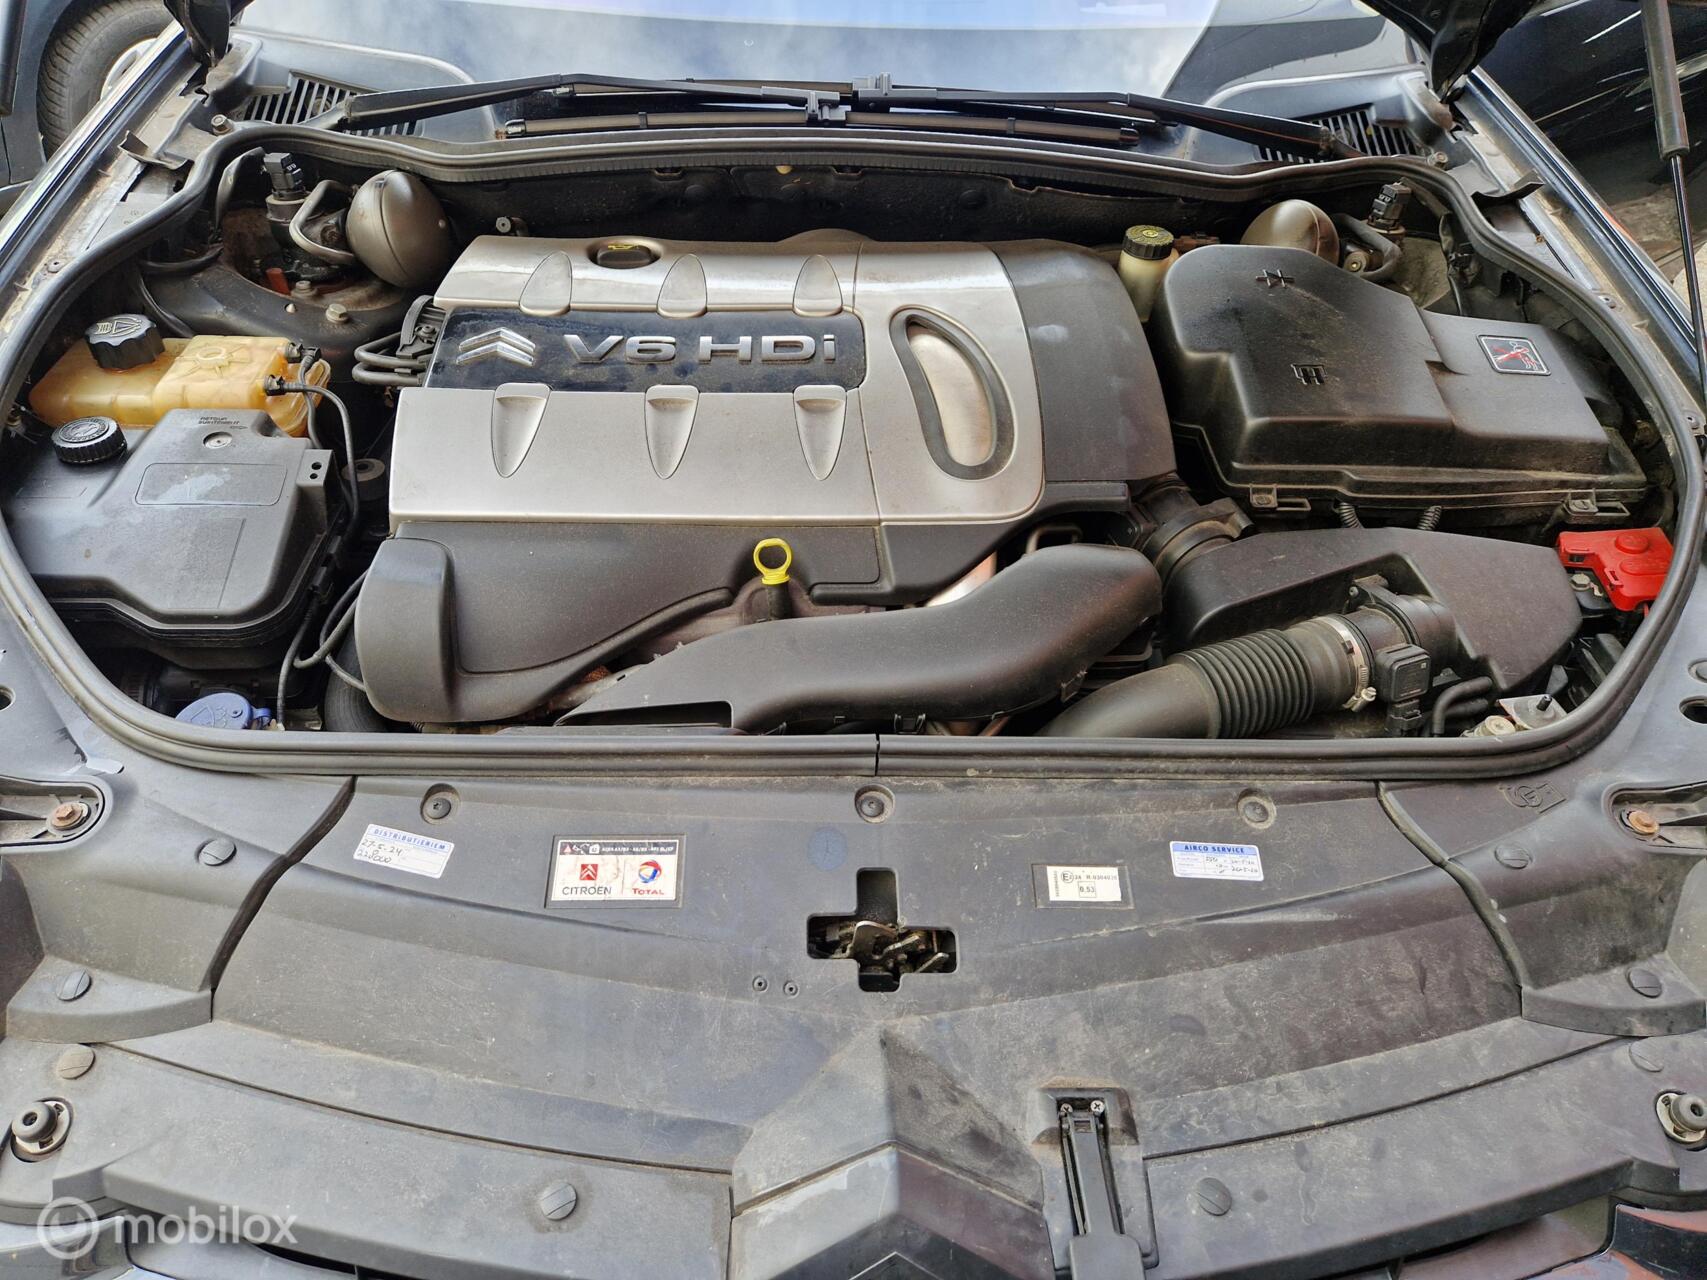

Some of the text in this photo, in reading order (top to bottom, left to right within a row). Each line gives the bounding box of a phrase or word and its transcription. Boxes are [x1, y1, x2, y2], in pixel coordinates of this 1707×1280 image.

[563, 333, 836, 363] V6 HDi
[1184, 844, 1245, 854] AIRCO SERVICE
[632, 887, 665, 896] TOTAL
